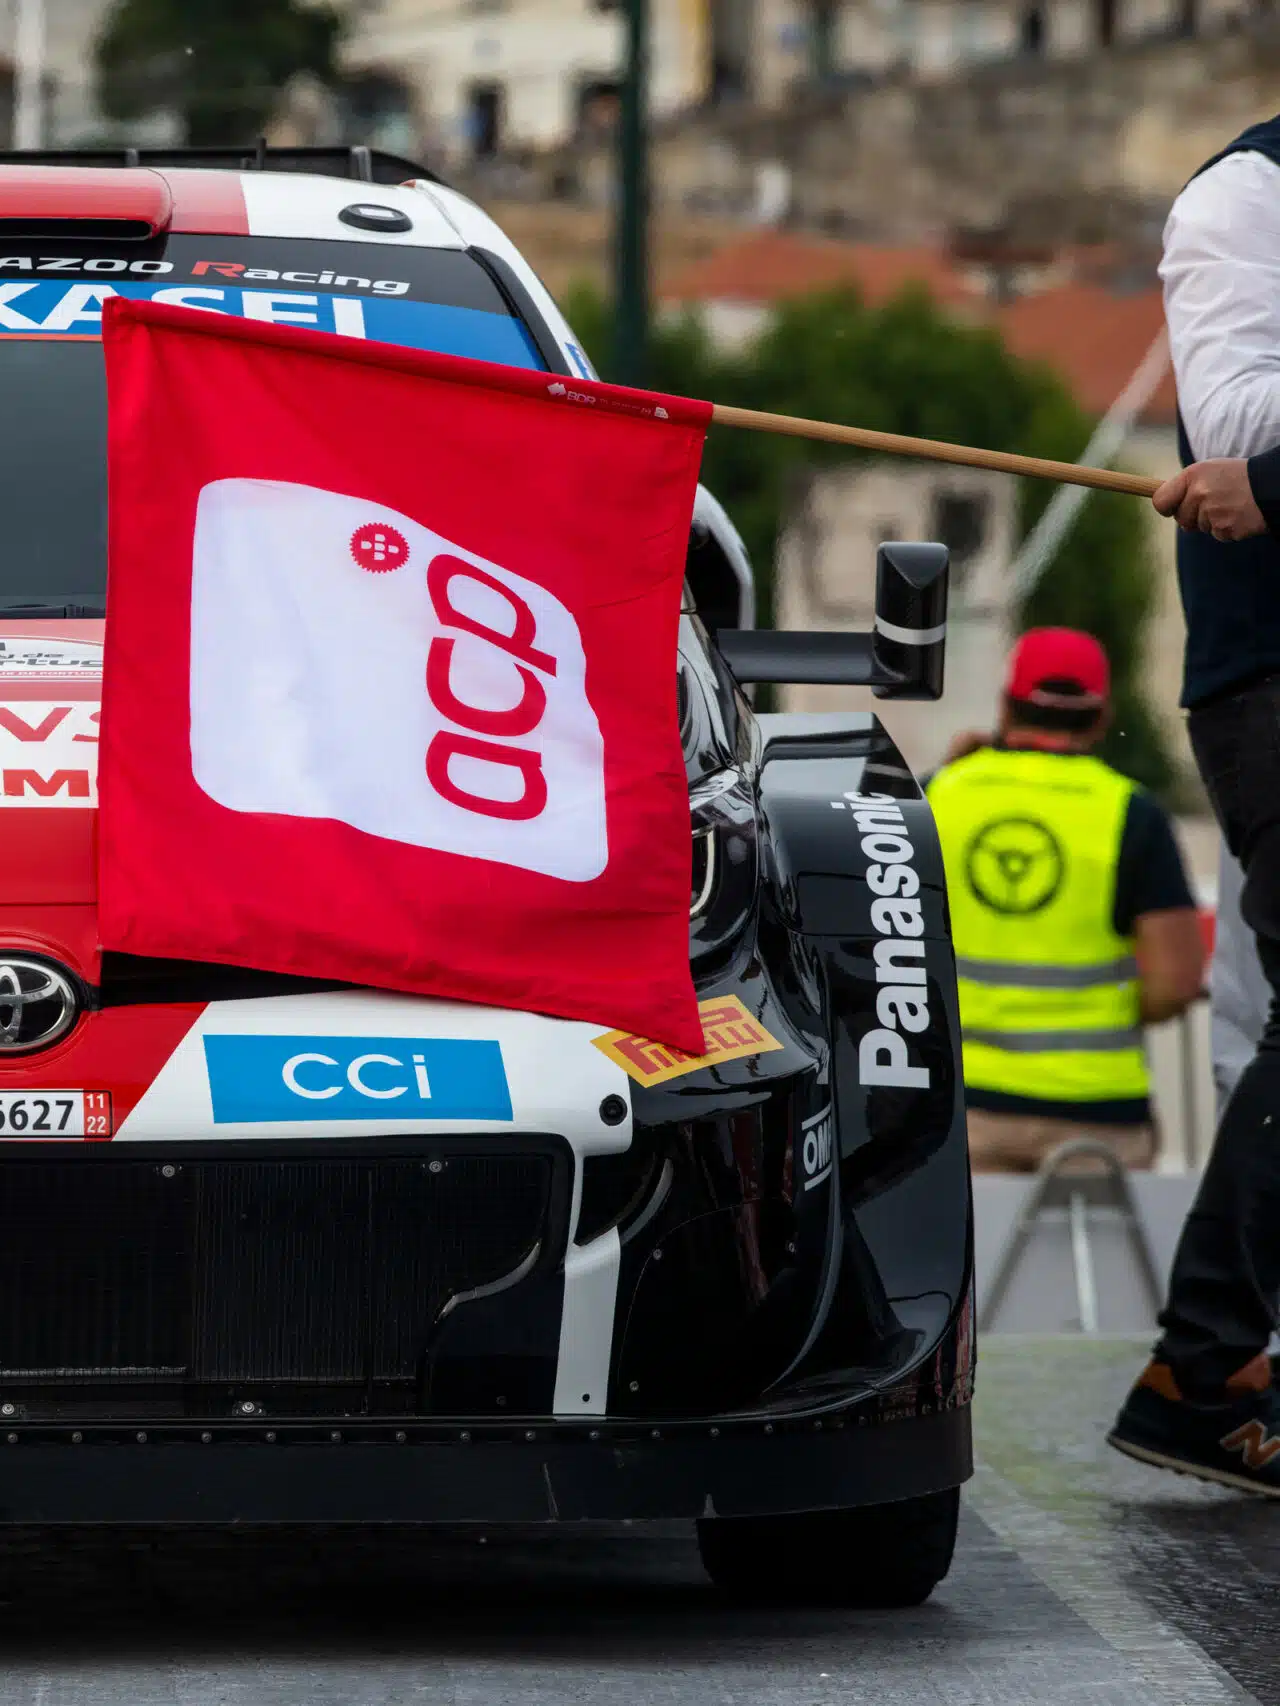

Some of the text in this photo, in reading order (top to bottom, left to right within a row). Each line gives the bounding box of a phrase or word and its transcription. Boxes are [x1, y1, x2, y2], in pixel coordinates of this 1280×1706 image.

[191, 260, 411, 296] Racing
[425, 553, 558, 822] acp
[3, 768, 97, 798] M
[831, 791, 931, 1090] Panasonic
[86, 1093, 105, 1109] 11
[86, 1115, 106, 1134] 22
